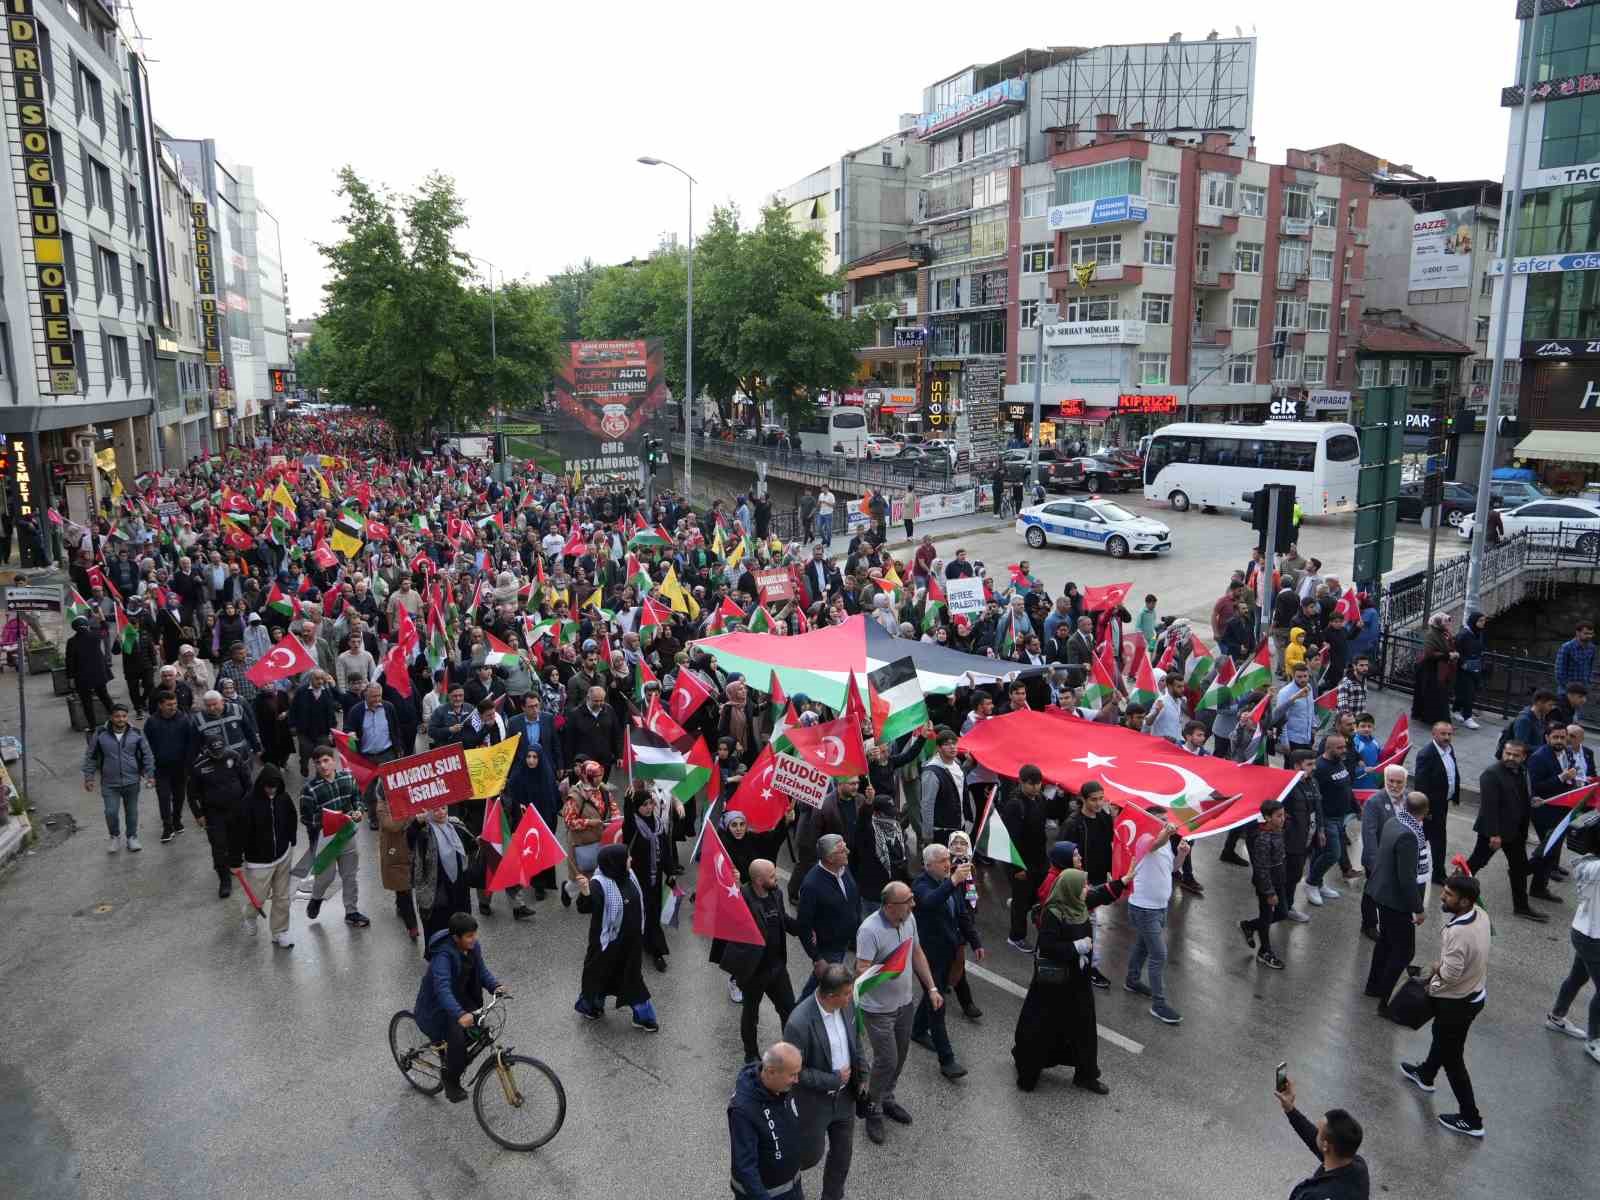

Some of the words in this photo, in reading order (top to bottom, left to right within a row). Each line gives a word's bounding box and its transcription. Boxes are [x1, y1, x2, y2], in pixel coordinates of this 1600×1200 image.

[1414, 218, 1448, 231] GAZZE
[41, 267, 73, 365] OTEL
[203, 300, 217, 350] OTEL
[1057, 327, 1083, 336] SERHAT
[619, 368, 647, 378] AUTO
[601, 441, 624, 454] GMG
[13, 440, 30, 502] KISMET
[386, 754, 463, 791] KAHROLSUN
[775, 773, 823, 800] BİZİMDİR
[779, 757, 828, 788] KUDÜS
